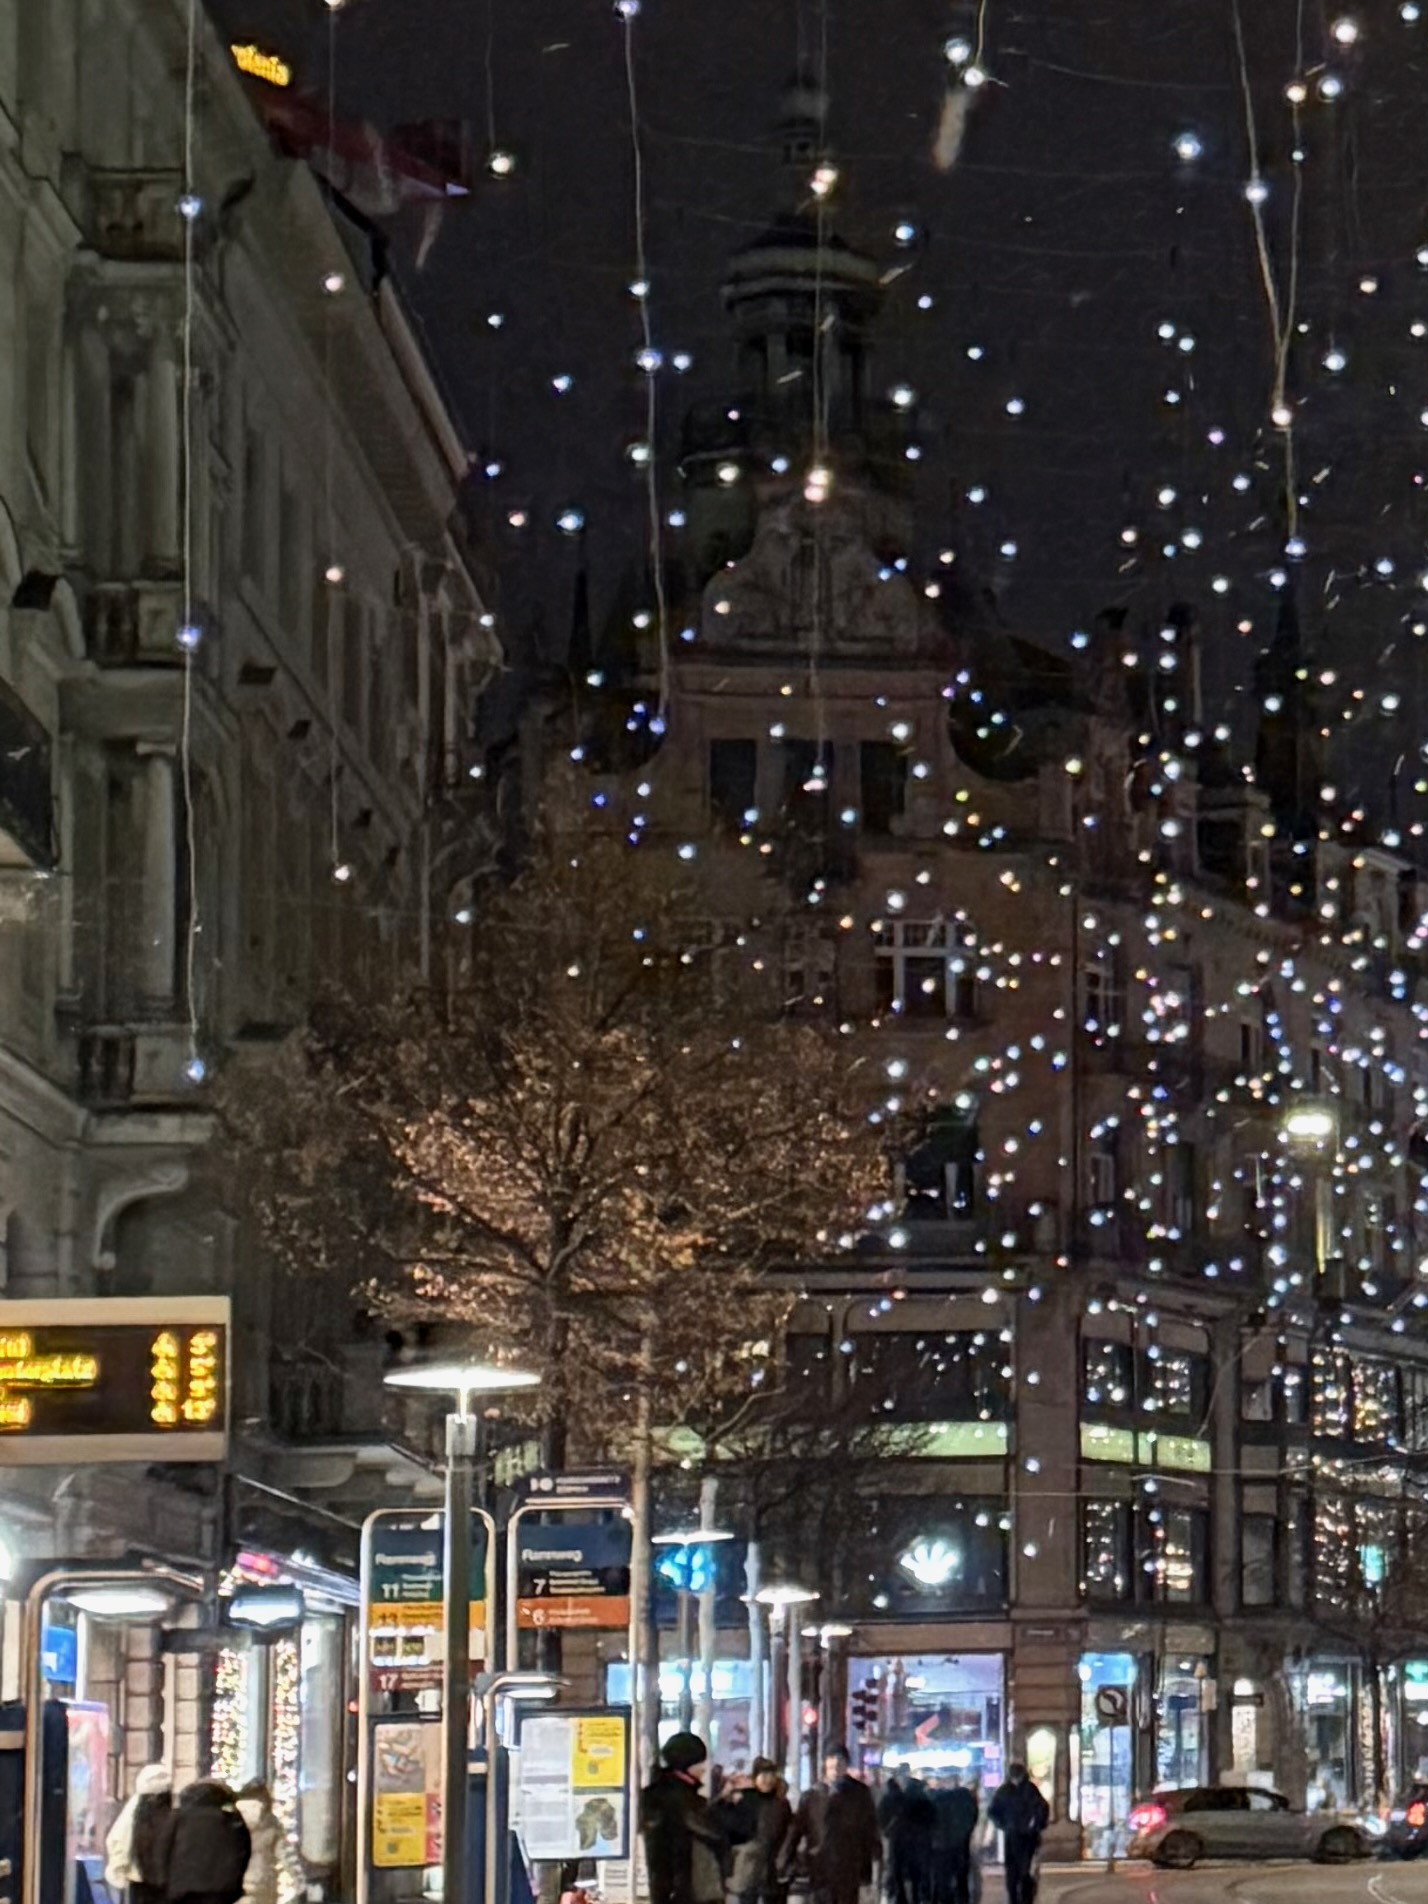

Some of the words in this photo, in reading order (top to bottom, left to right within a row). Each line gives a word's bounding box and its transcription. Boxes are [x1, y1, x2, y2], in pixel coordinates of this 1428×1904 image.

[381, 1582, 400, 1599] 11
[533, 1578, 546, 1595] 7
[379, 1673, 399, 1690] 17
